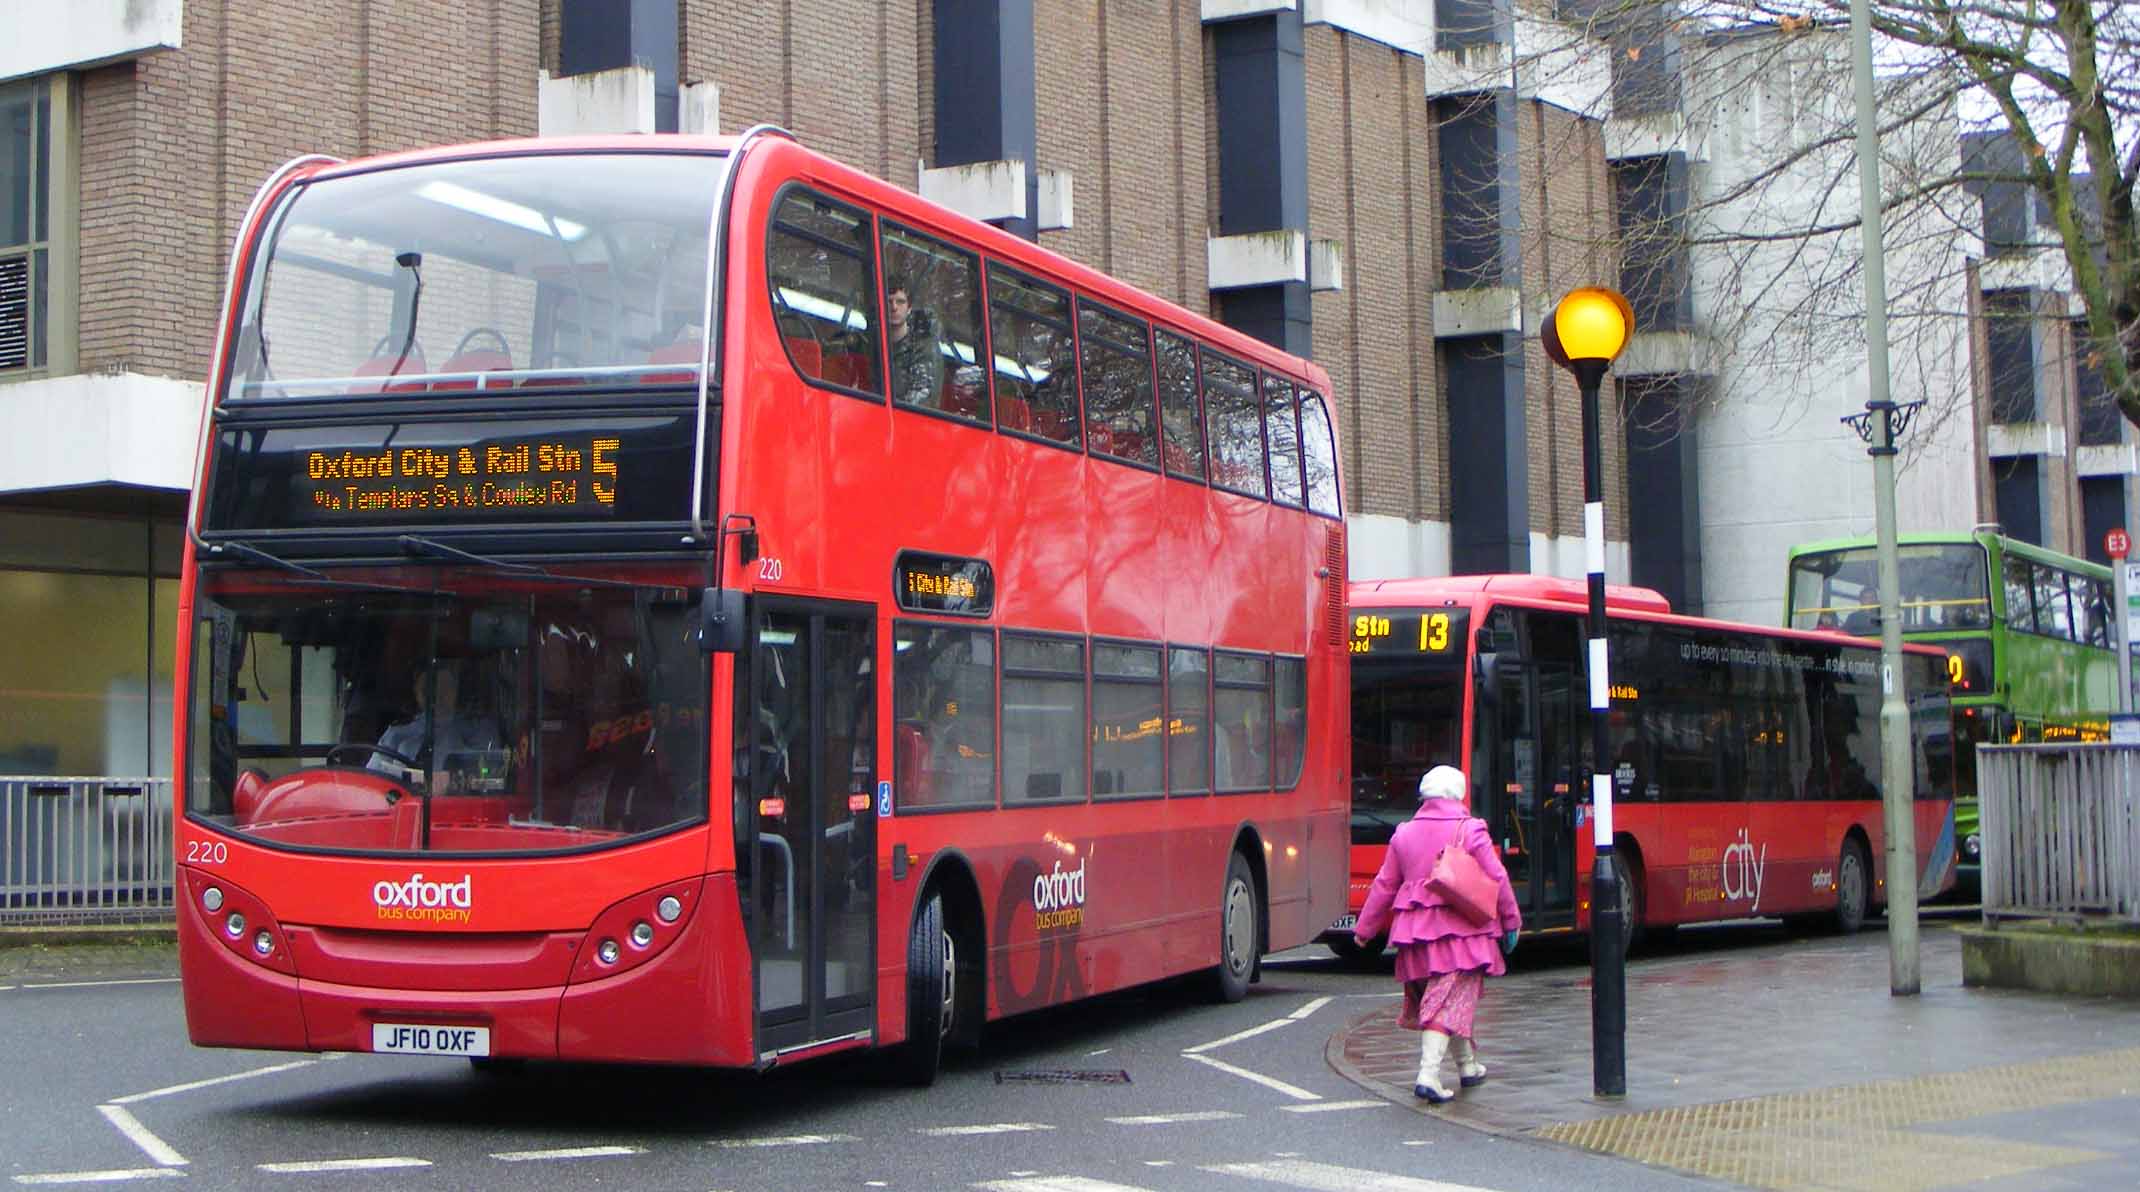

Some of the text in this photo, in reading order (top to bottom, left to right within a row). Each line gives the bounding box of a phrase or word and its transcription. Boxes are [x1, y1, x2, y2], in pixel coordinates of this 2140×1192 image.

[308, 438, 620, 508] Oxford City & Rail Stn 5
[344, 483, 430, 511] Templars
[464, 481, 478, 508] &
[481, 481, 547, 508] Cowley
[551, 479, 577, 505] Rd
[2108, 534, 2127, 552] E3
[760, 557, 782, 581] 220
[1355, 613, 1450, 651] Stn 13
[187, 841, 228, 864] 220
[1723, 827, 1766, 912] city
[373, 873, 472, 908] oxford
[1033, 857, 1085, 912] oxford
[377, 907, 472, 925] bus company
[1036, 907, 1085, 930] bus company
[386, 1027, 477, 1051] JF10 OXF
